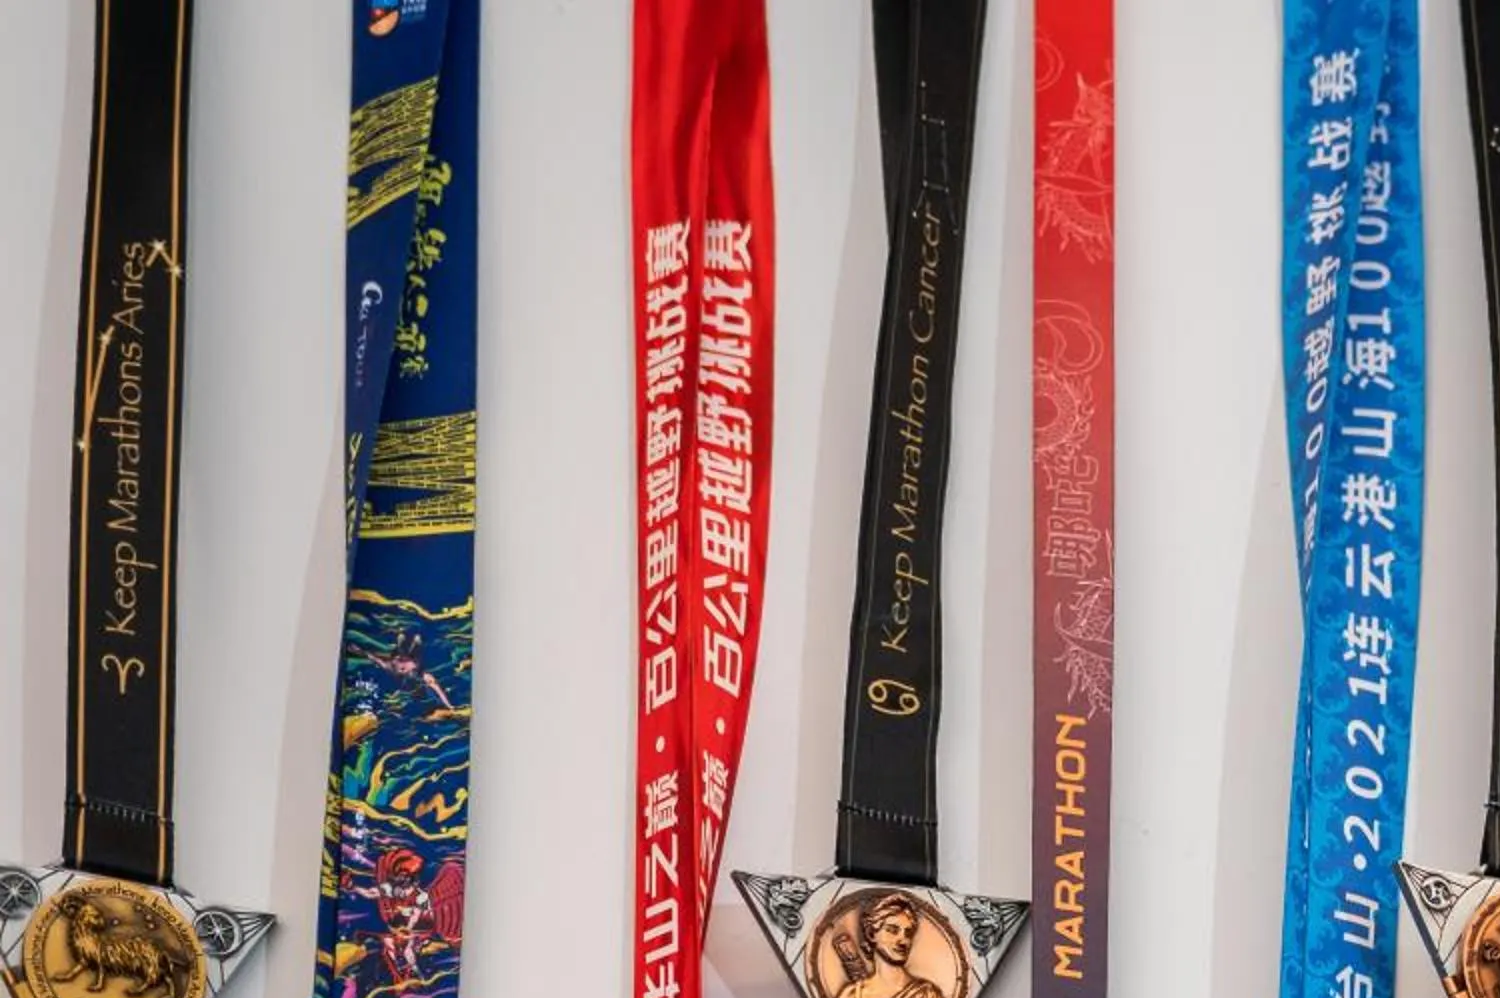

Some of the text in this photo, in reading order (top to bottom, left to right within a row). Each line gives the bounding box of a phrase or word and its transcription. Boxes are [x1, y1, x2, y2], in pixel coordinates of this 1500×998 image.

[97, 241, 158, 637] Keep Marathons Aries
[880, 203, 944, 654] Keep Marathon Cancer
[1052, 712, 1089, 980] MARATHON
